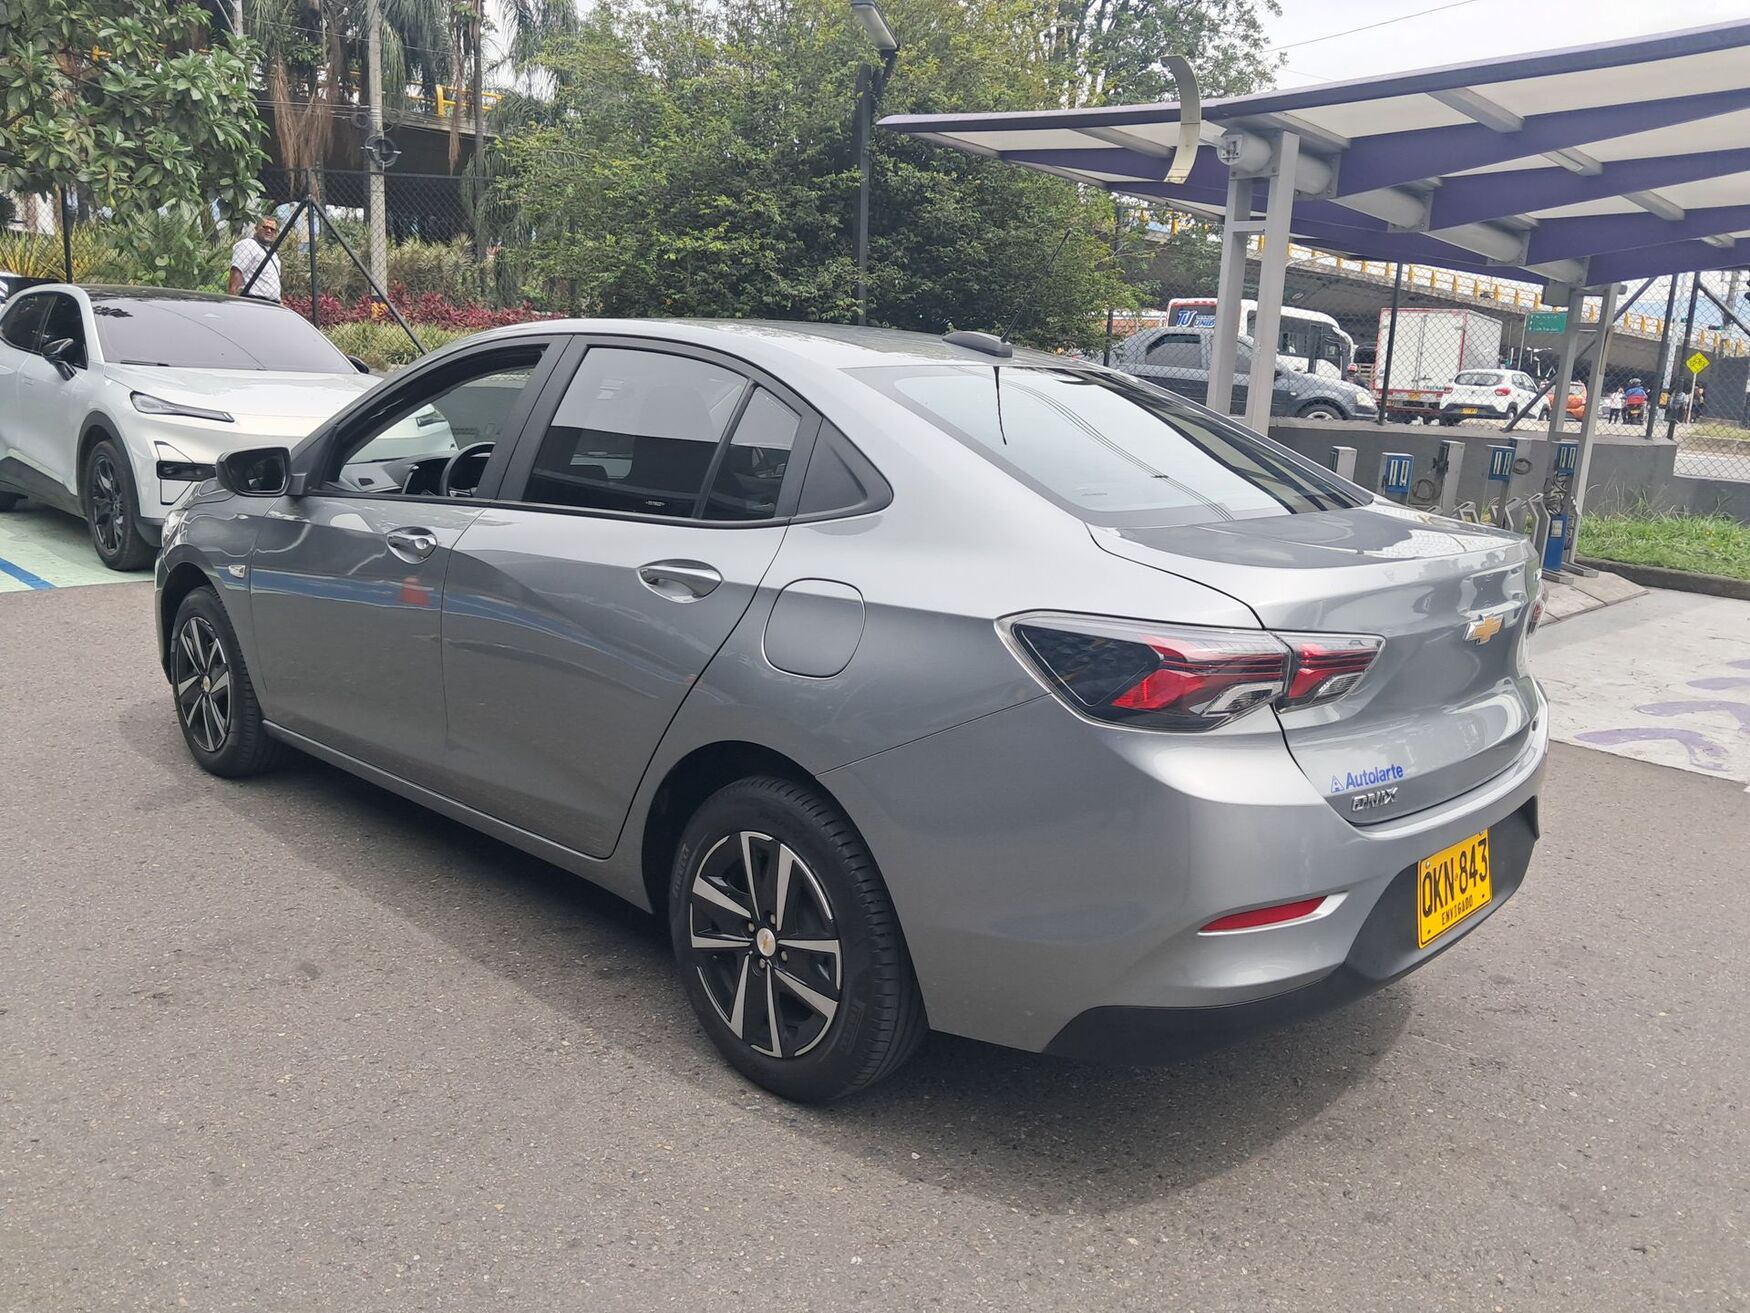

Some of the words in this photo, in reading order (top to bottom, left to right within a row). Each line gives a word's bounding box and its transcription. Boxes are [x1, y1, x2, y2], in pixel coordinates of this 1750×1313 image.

[1193, 319, 1217, 328] UNID
[1346, 763, 1404, 789] Autolarte
[1352, 787, 1398, 811] ONIX
[1459, 837, 1488, 894] 843
[1441, 895, 1474, 926] ENVIGADO
